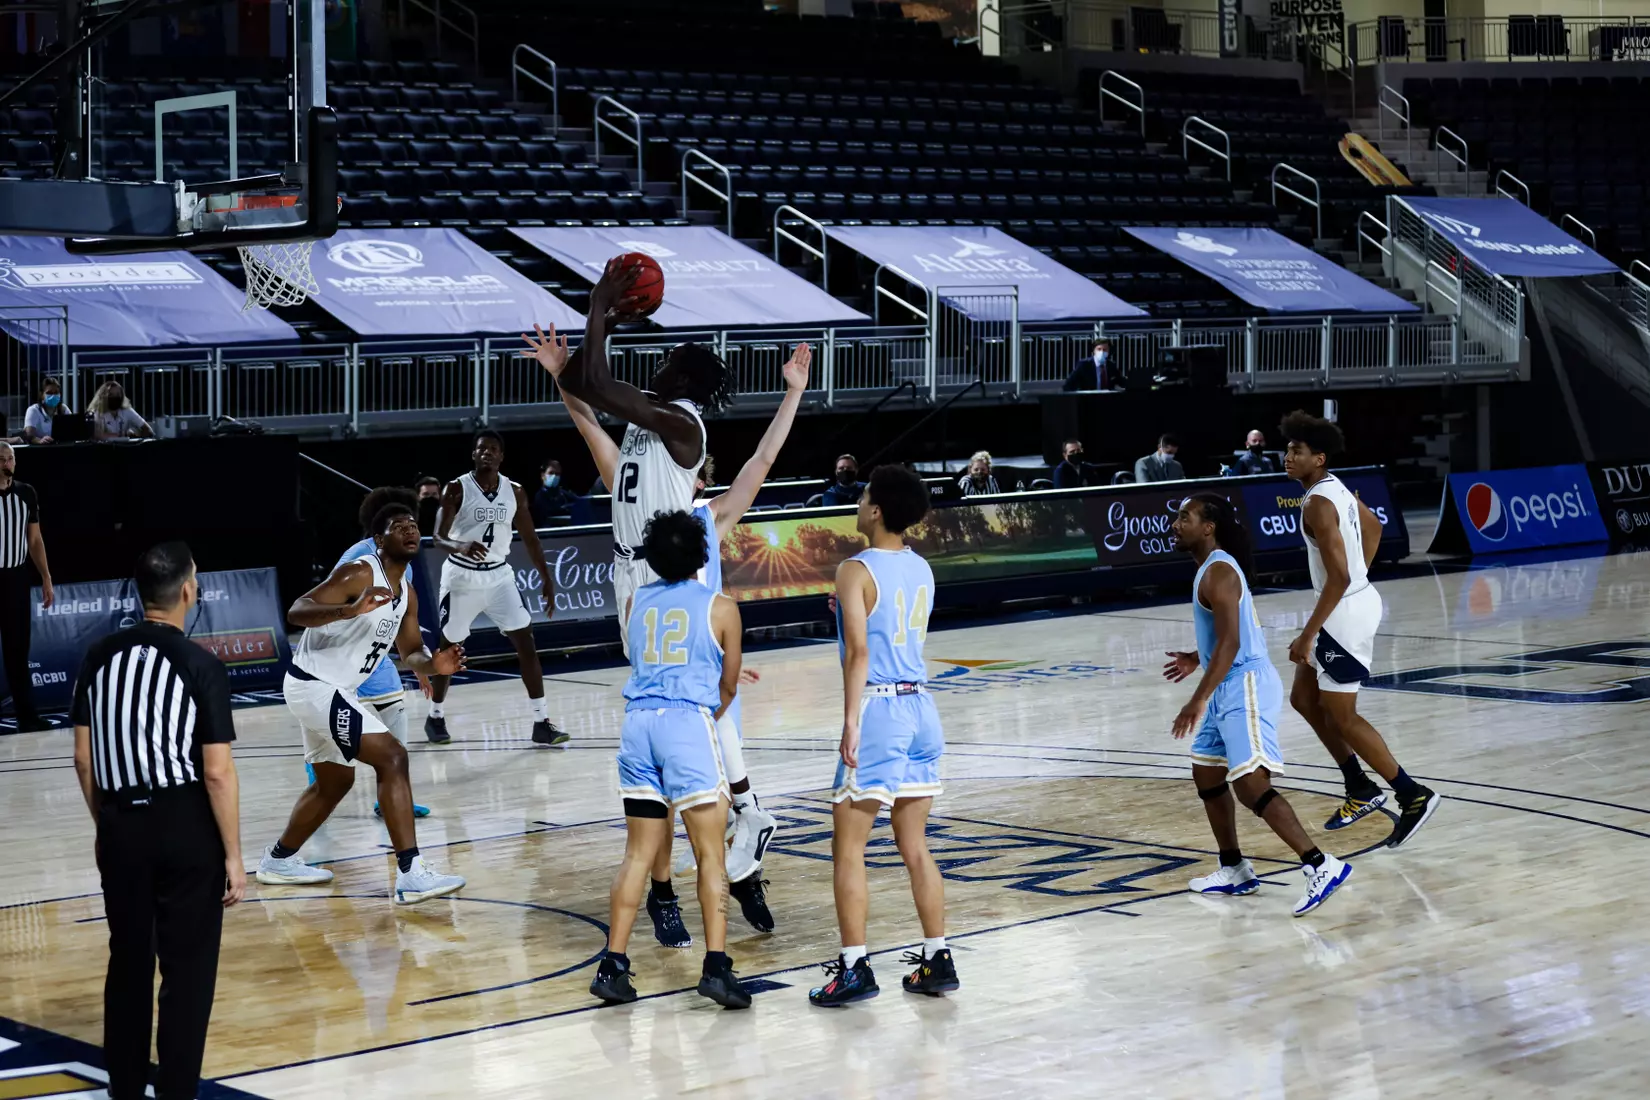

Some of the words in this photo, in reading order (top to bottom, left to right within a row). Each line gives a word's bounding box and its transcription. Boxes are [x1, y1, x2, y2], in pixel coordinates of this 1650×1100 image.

[1271, 0, 1342, 16] PURPOSE
[1520, 243, 1584, 256] Relief
[912, 253, 1038, 273] Altura
[29, 266, 176, 282] provider
[327, 274, 501, 288] MAGNOLIA
[47, 283, 105, 293] contract
[109, 283, 141, 292] food
[1256, 280, 1320, 291] CLINIC
[618, 462, 639, 504] 12
[474, 507, 507, 522] CBU
[1510, 484, 1587, 532] pepsi
[1104, 502, 1171, 551] Goose
[1260, 514, 1297, 536] CBU
[482, 523, 494, 548] 4
[1140, 537, 1177, 555] GOLF
[543, 546, 615, 589] Cree
[37, 598, 102, 616] Fueled
[109, 597, 136, 613] by
[554, 590, 604, 611] CLUB
[893, 585, 928, 645] 14
[643, 607, 690, 665] 12
[209, 637, 265, 657] vider
[43, 672, 67, 684] CBU
[240, 666, 270, 676] service
[336, 708, 351, 747] LANCERS
